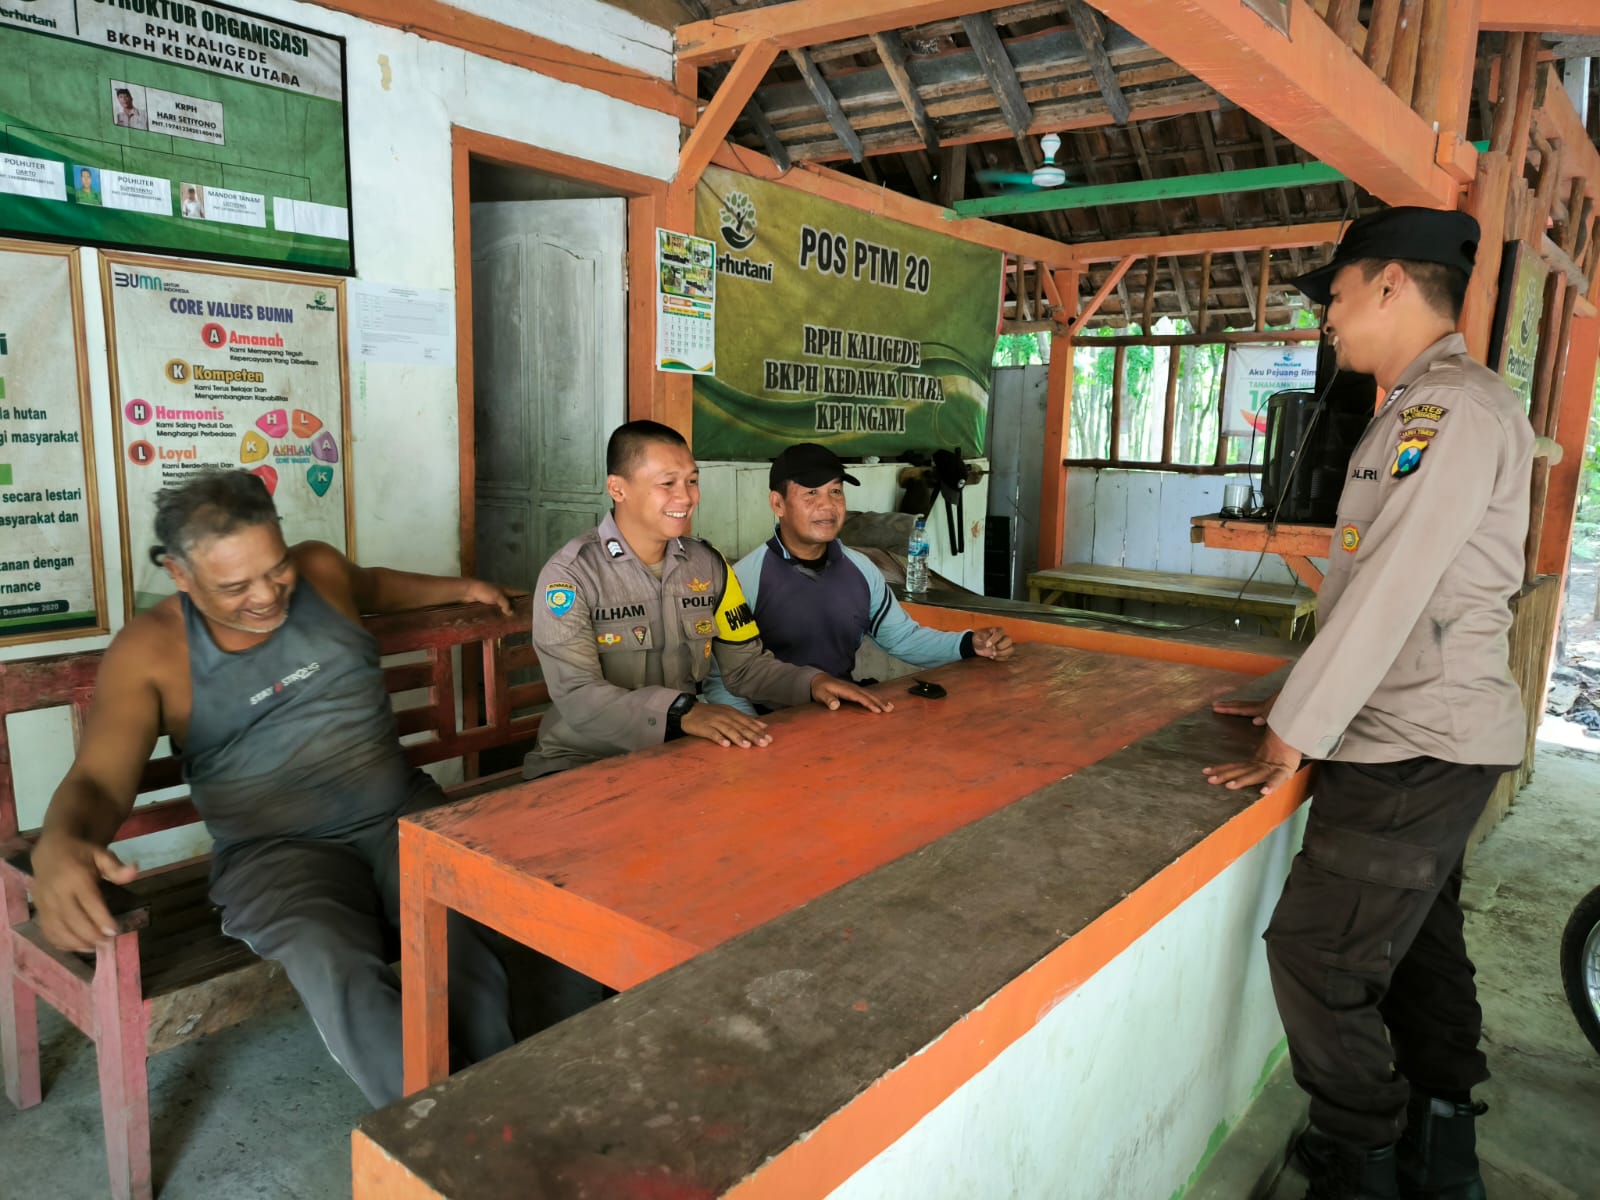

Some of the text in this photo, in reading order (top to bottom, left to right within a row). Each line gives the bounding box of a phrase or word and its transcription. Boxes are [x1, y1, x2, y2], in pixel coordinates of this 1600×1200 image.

[0, 7, 57, 29] erhutani
[202, 10, 309, 57] ORGANISASI
[145, 22, 267, 64] RPH KALIGEDE
[106, 29, 301, 87] BKPH KEDAWAK UTARA
[175, 102, 198, 114] KRPH
[157, 111, 217, 129] HARI SETIYONO
[4, 158, 46, 170] POLHUTER
[117, 175, 154, 187] POLHUTER
[208, 190, 237, 200] MANDOR
[800, 227, 930, 293] POS PTM 20
[170, 297, 294, 324] CORE VALUES BUMN
[209, 328, 220, 343] A
[229, 329, 284, 348] Amanah
[247, 347, 284, 357] Memegang
[803, 325, 921, 367] RPH KALIGEDE
[172, 364, 184, 379] K
[193, 364, 264, 384] Kompeten
[1249, 368, 1265, 376] Aku
[1266, 368, 1299, 378] Pejuang
[764, 360, 945, 402] BKPH KEDAWAK UTARA
[194, 392, 253, 401] Mengembangkan
[13, 406, 47, 420] hutan
[133, 404, 146, 420] H
[155, 405, 225, 421] Harmonis
[266, 413, 309, 425] H L
[815, 403, 905, 433] KPH NGAWI
[11, 430, 79, 446] masyarakat
[156, 430, 236, 438] Menghargai Perbedaan
[138, 446, 147, 460] L
[158, 445, 197, 462] Loyal
[272, 444, 311, 456] AKHLAK
[2, 488, 81, 503] secara lestari
[58, 511, 79, 523] dan
[33, 556, 74, 570] dengan
[595, 604, 645, 621] ILHAM
